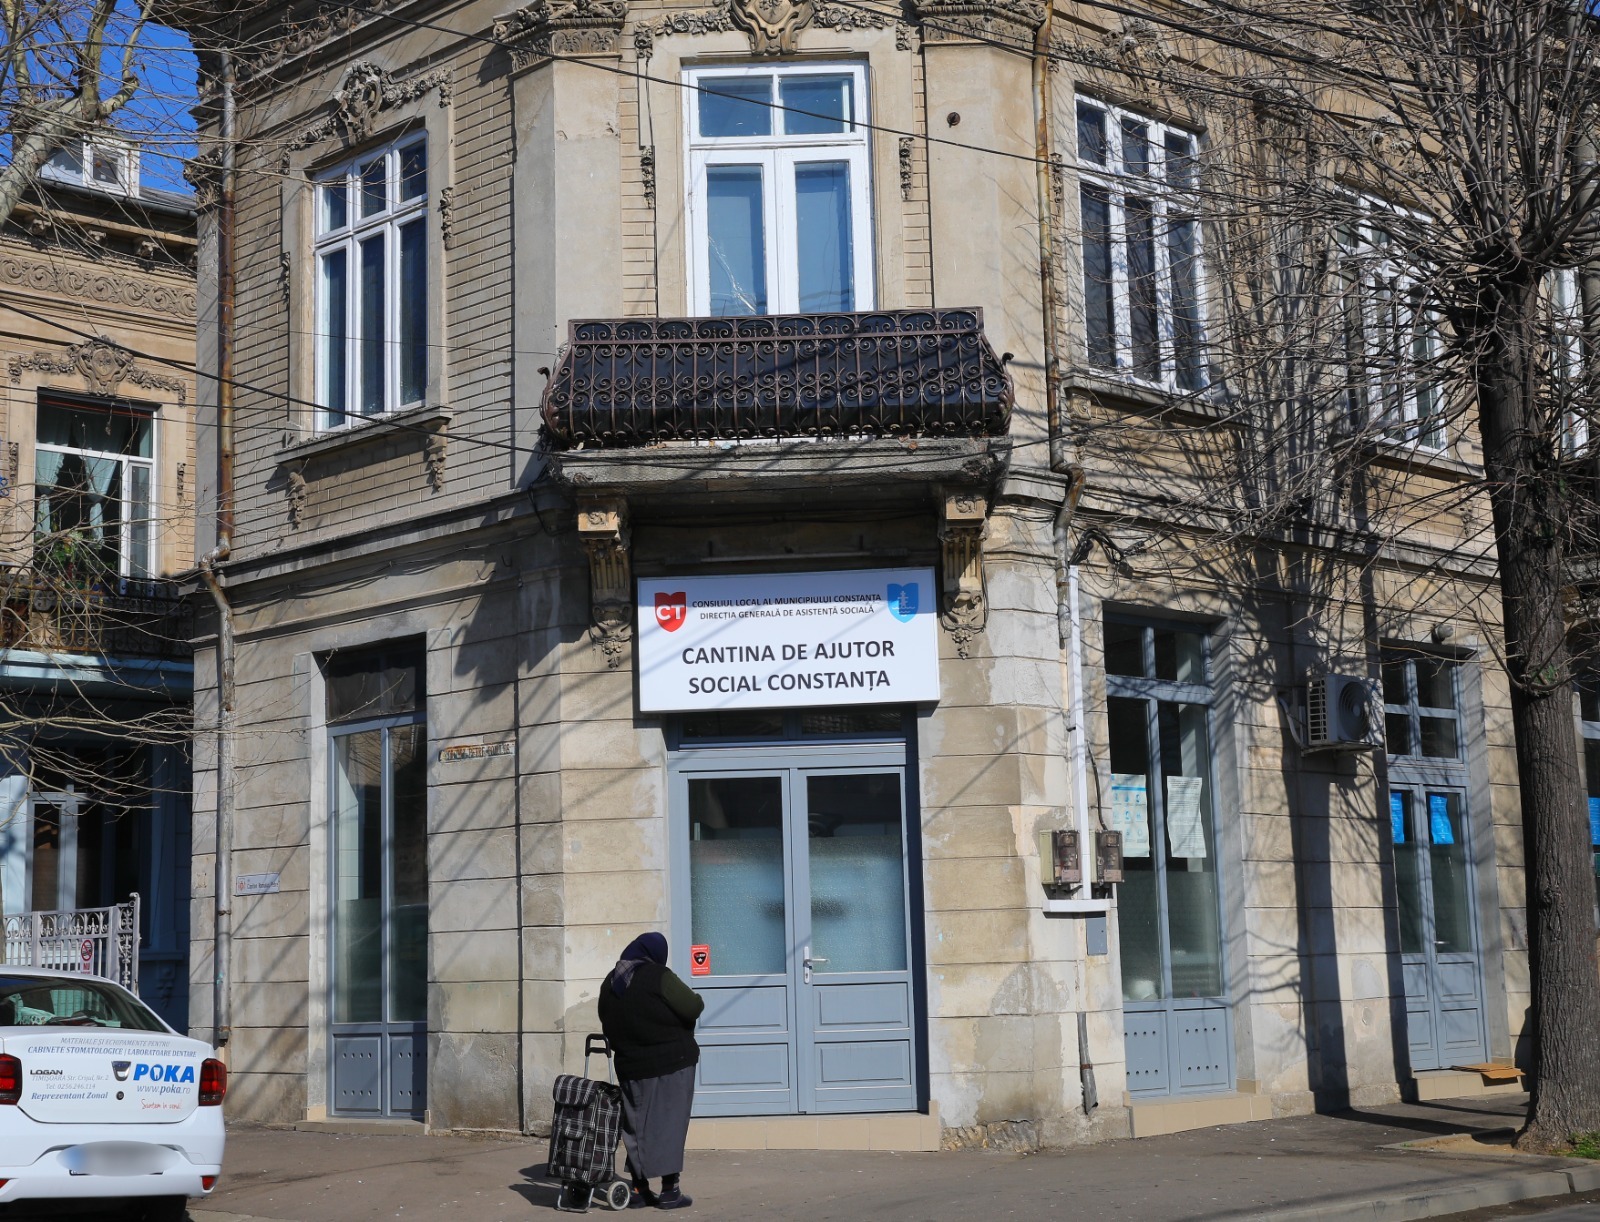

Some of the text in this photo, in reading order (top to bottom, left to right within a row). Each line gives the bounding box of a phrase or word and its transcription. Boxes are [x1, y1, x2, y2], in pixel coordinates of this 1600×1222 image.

[692, 600, 733, 608] CONSILIUL
[735, 599, 761, 607] LOCAL
[763, 598, 773, 606] AL
[775, 596, 832, 605] MUNICIPIULUI
[656, 604, 685, 620] CT
[739, 608, 781, 618] GENERALĂ
[783, 609, 794, 617] DE
[840, 604, 875, 615] SOCIALĂ
[682, 640, 895, 665] CANTINA DE AJUTOR
[688, 670, 891, 694] SOCIAL CONSTANȚA
[61, 1037, 97, 1045] MATERIALE
[66, 1047, 123, 1055] STOMATOLOGICE
[133, 1064, 195, 1083] POKA
[137, 1084, 191, 1095] www.poka.ro
[31, 1092, 85, 1101] Reprezentant
